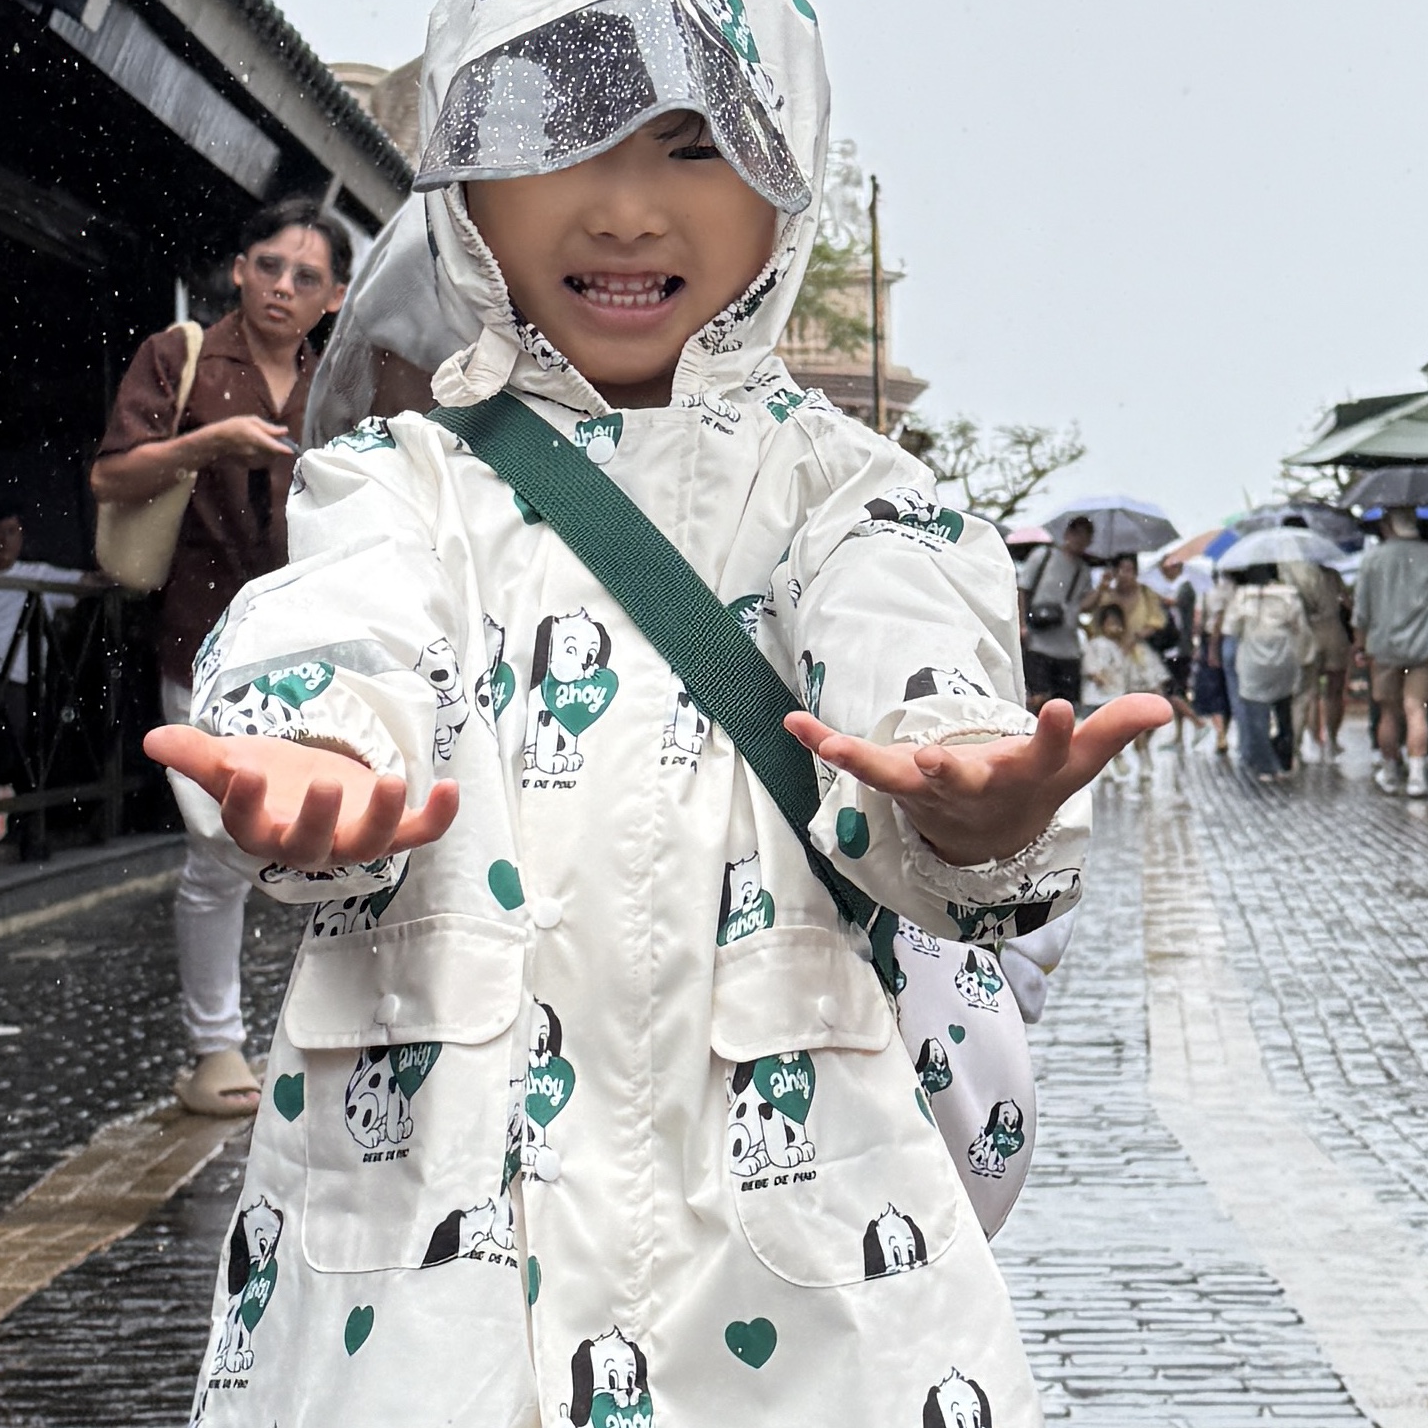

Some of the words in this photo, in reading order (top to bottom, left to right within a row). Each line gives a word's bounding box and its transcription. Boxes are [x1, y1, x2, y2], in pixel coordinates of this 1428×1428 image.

[555, 683, 608, 714] ahoy
[725, 906, 768, 943] ahoy
[769, 1067, 811, 1100] ahoy
